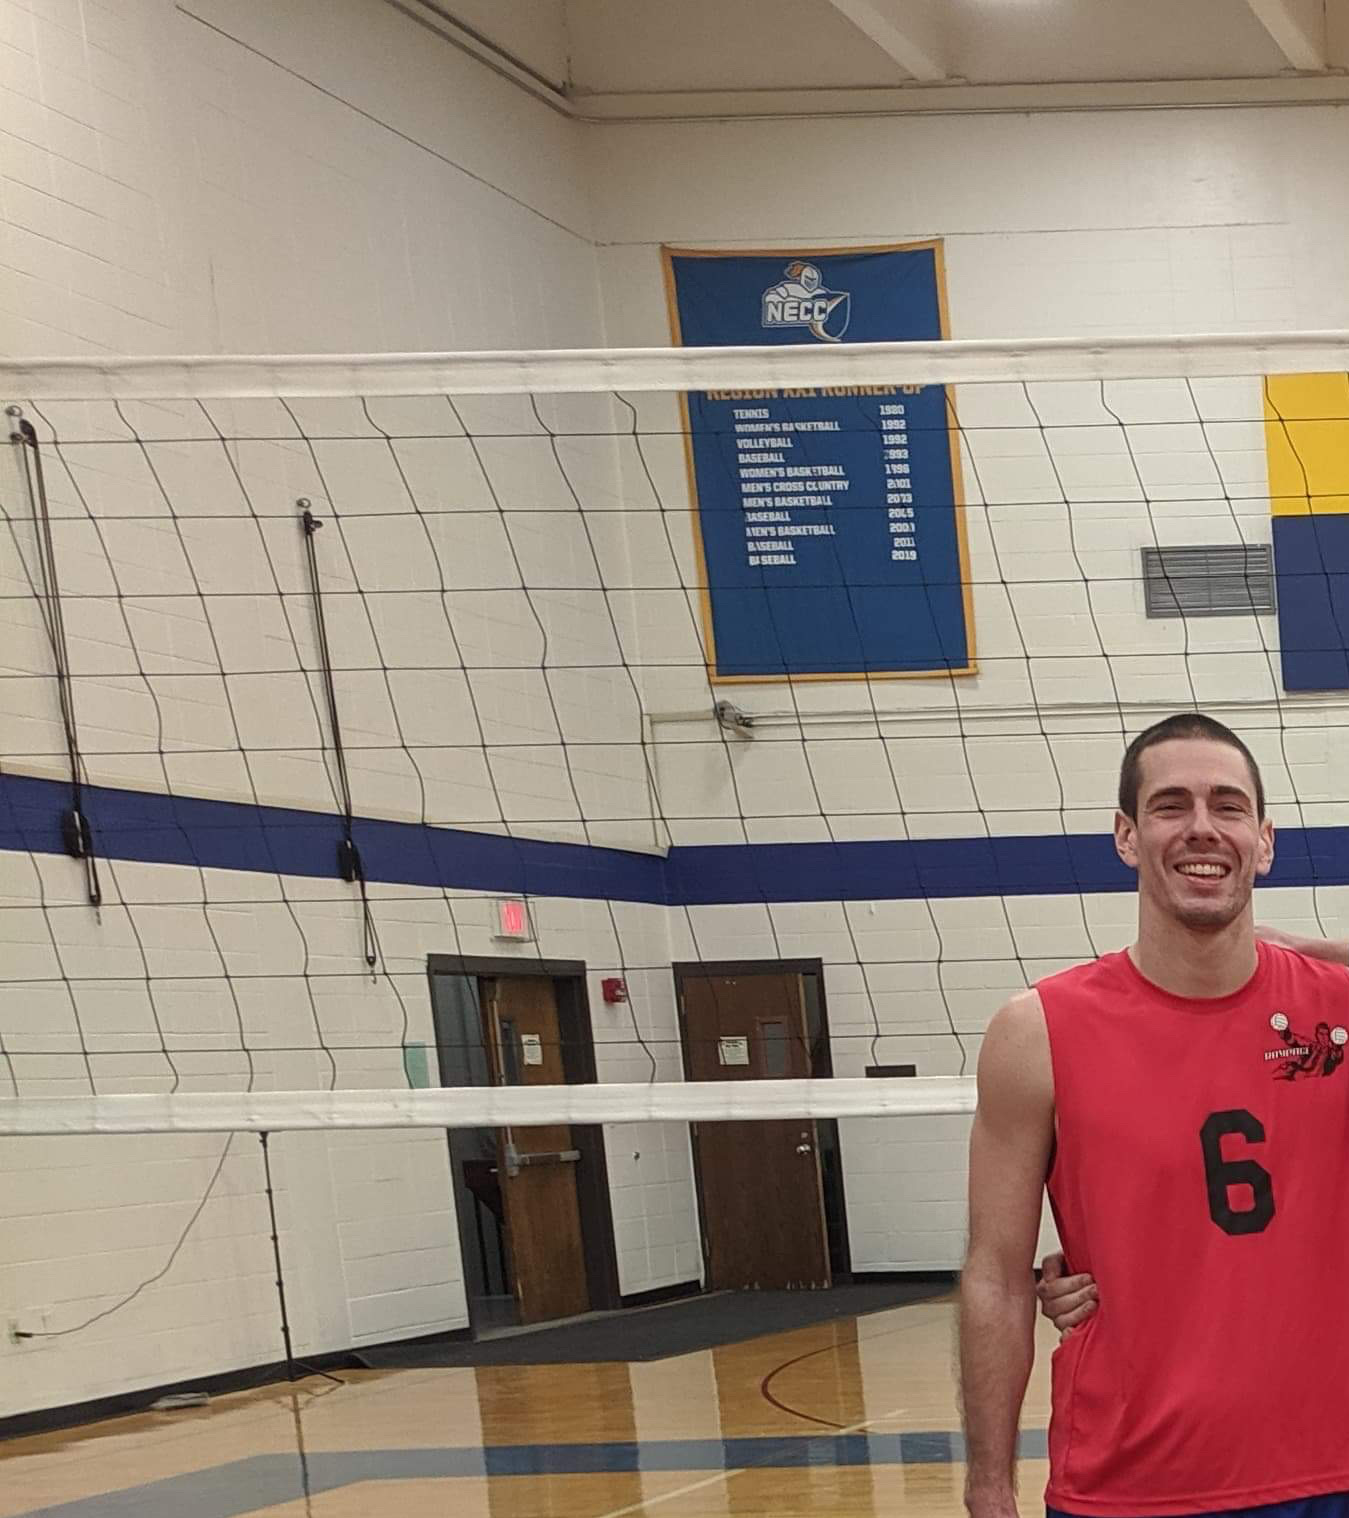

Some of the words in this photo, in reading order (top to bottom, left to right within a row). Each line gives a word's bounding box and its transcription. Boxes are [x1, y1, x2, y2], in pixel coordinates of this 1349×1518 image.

[767, 301, 827, 322] NECC
[733, 408, 769, 419] TENNIS
[736, 437, 793, 449] VOLLEYBALL
[738, 452, 785, 464] BASEBALL
[741, 482, 772, 493] MEN'S
[773, 481, 805, 492] CROSS
[805, 480, 849, 491] COUNTRY
[742, 497, 774, 508] MEN'S
[774, 495, 833, 507] BASKETBALL
[777, 524, 836, 536] BASKETBALL
[1199, 1108, 1276, 1236] 6
